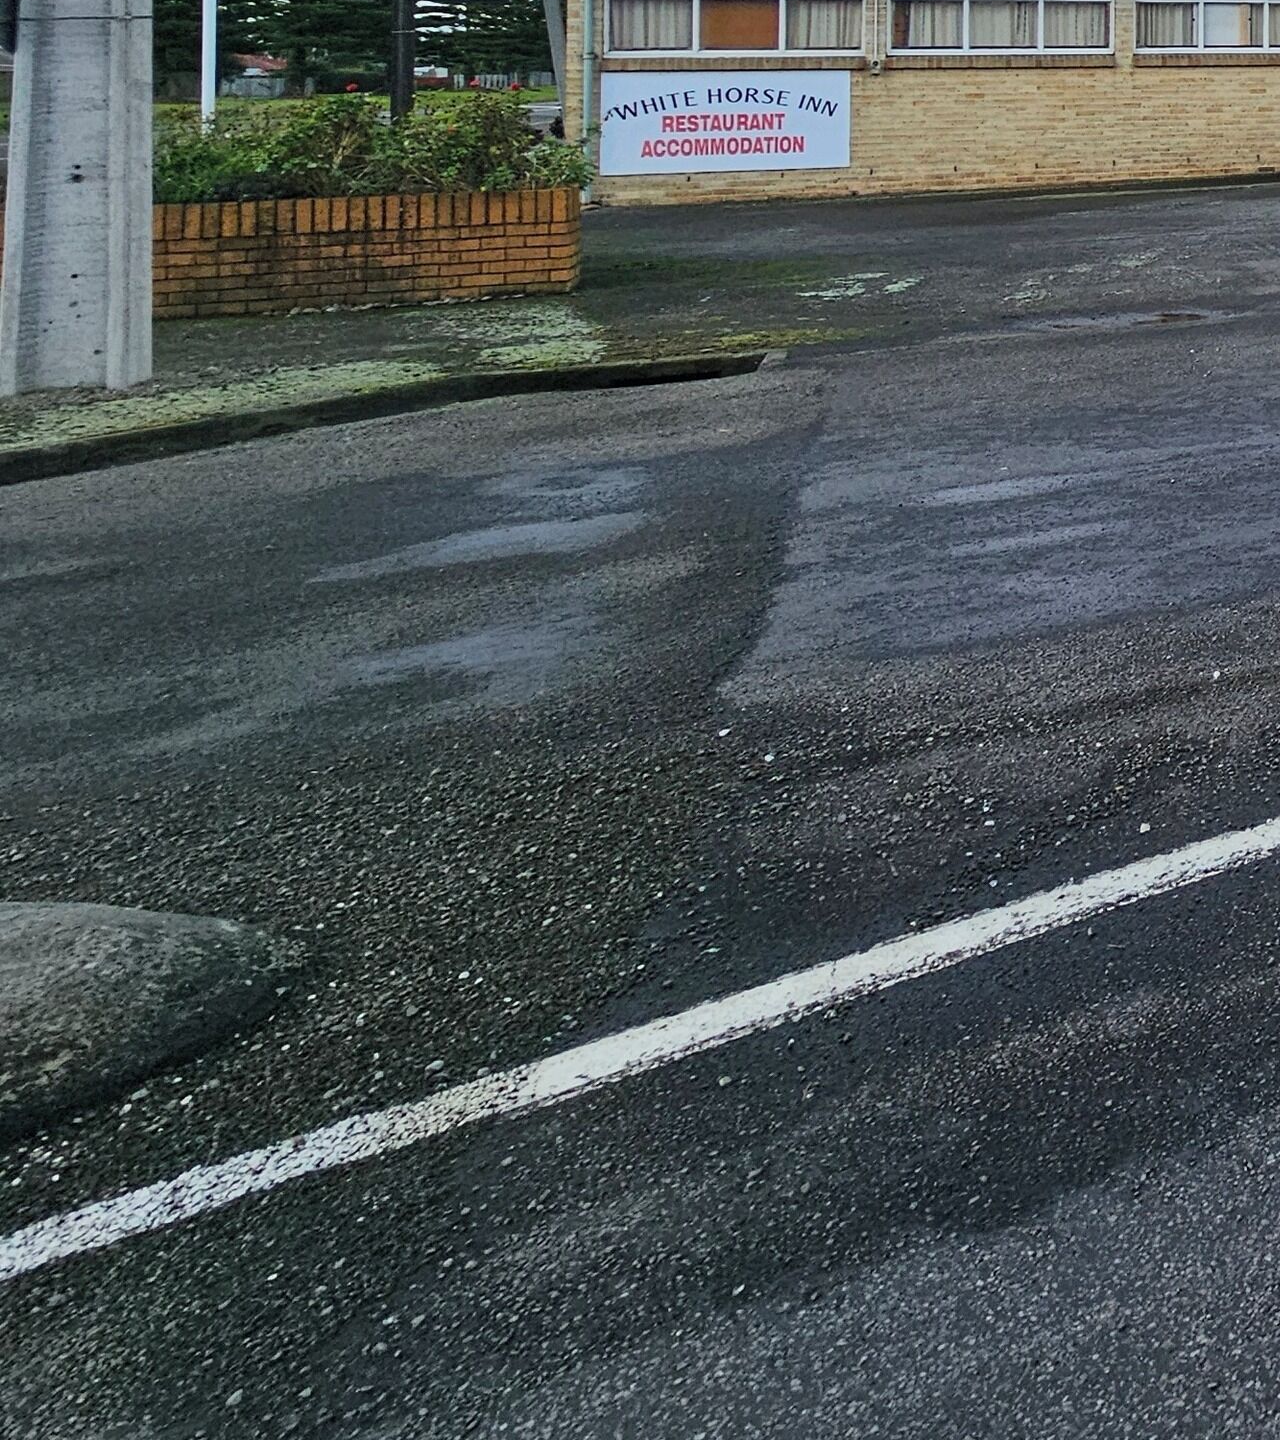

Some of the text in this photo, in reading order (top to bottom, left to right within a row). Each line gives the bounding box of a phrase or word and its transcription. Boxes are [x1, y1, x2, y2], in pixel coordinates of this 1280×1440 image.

[613, 87, 839, 121] WHITE HORSE INN
[661, 113, 786, 133] RESTAURANT
[641, 136, 805, 158] ACCOMMODATION
